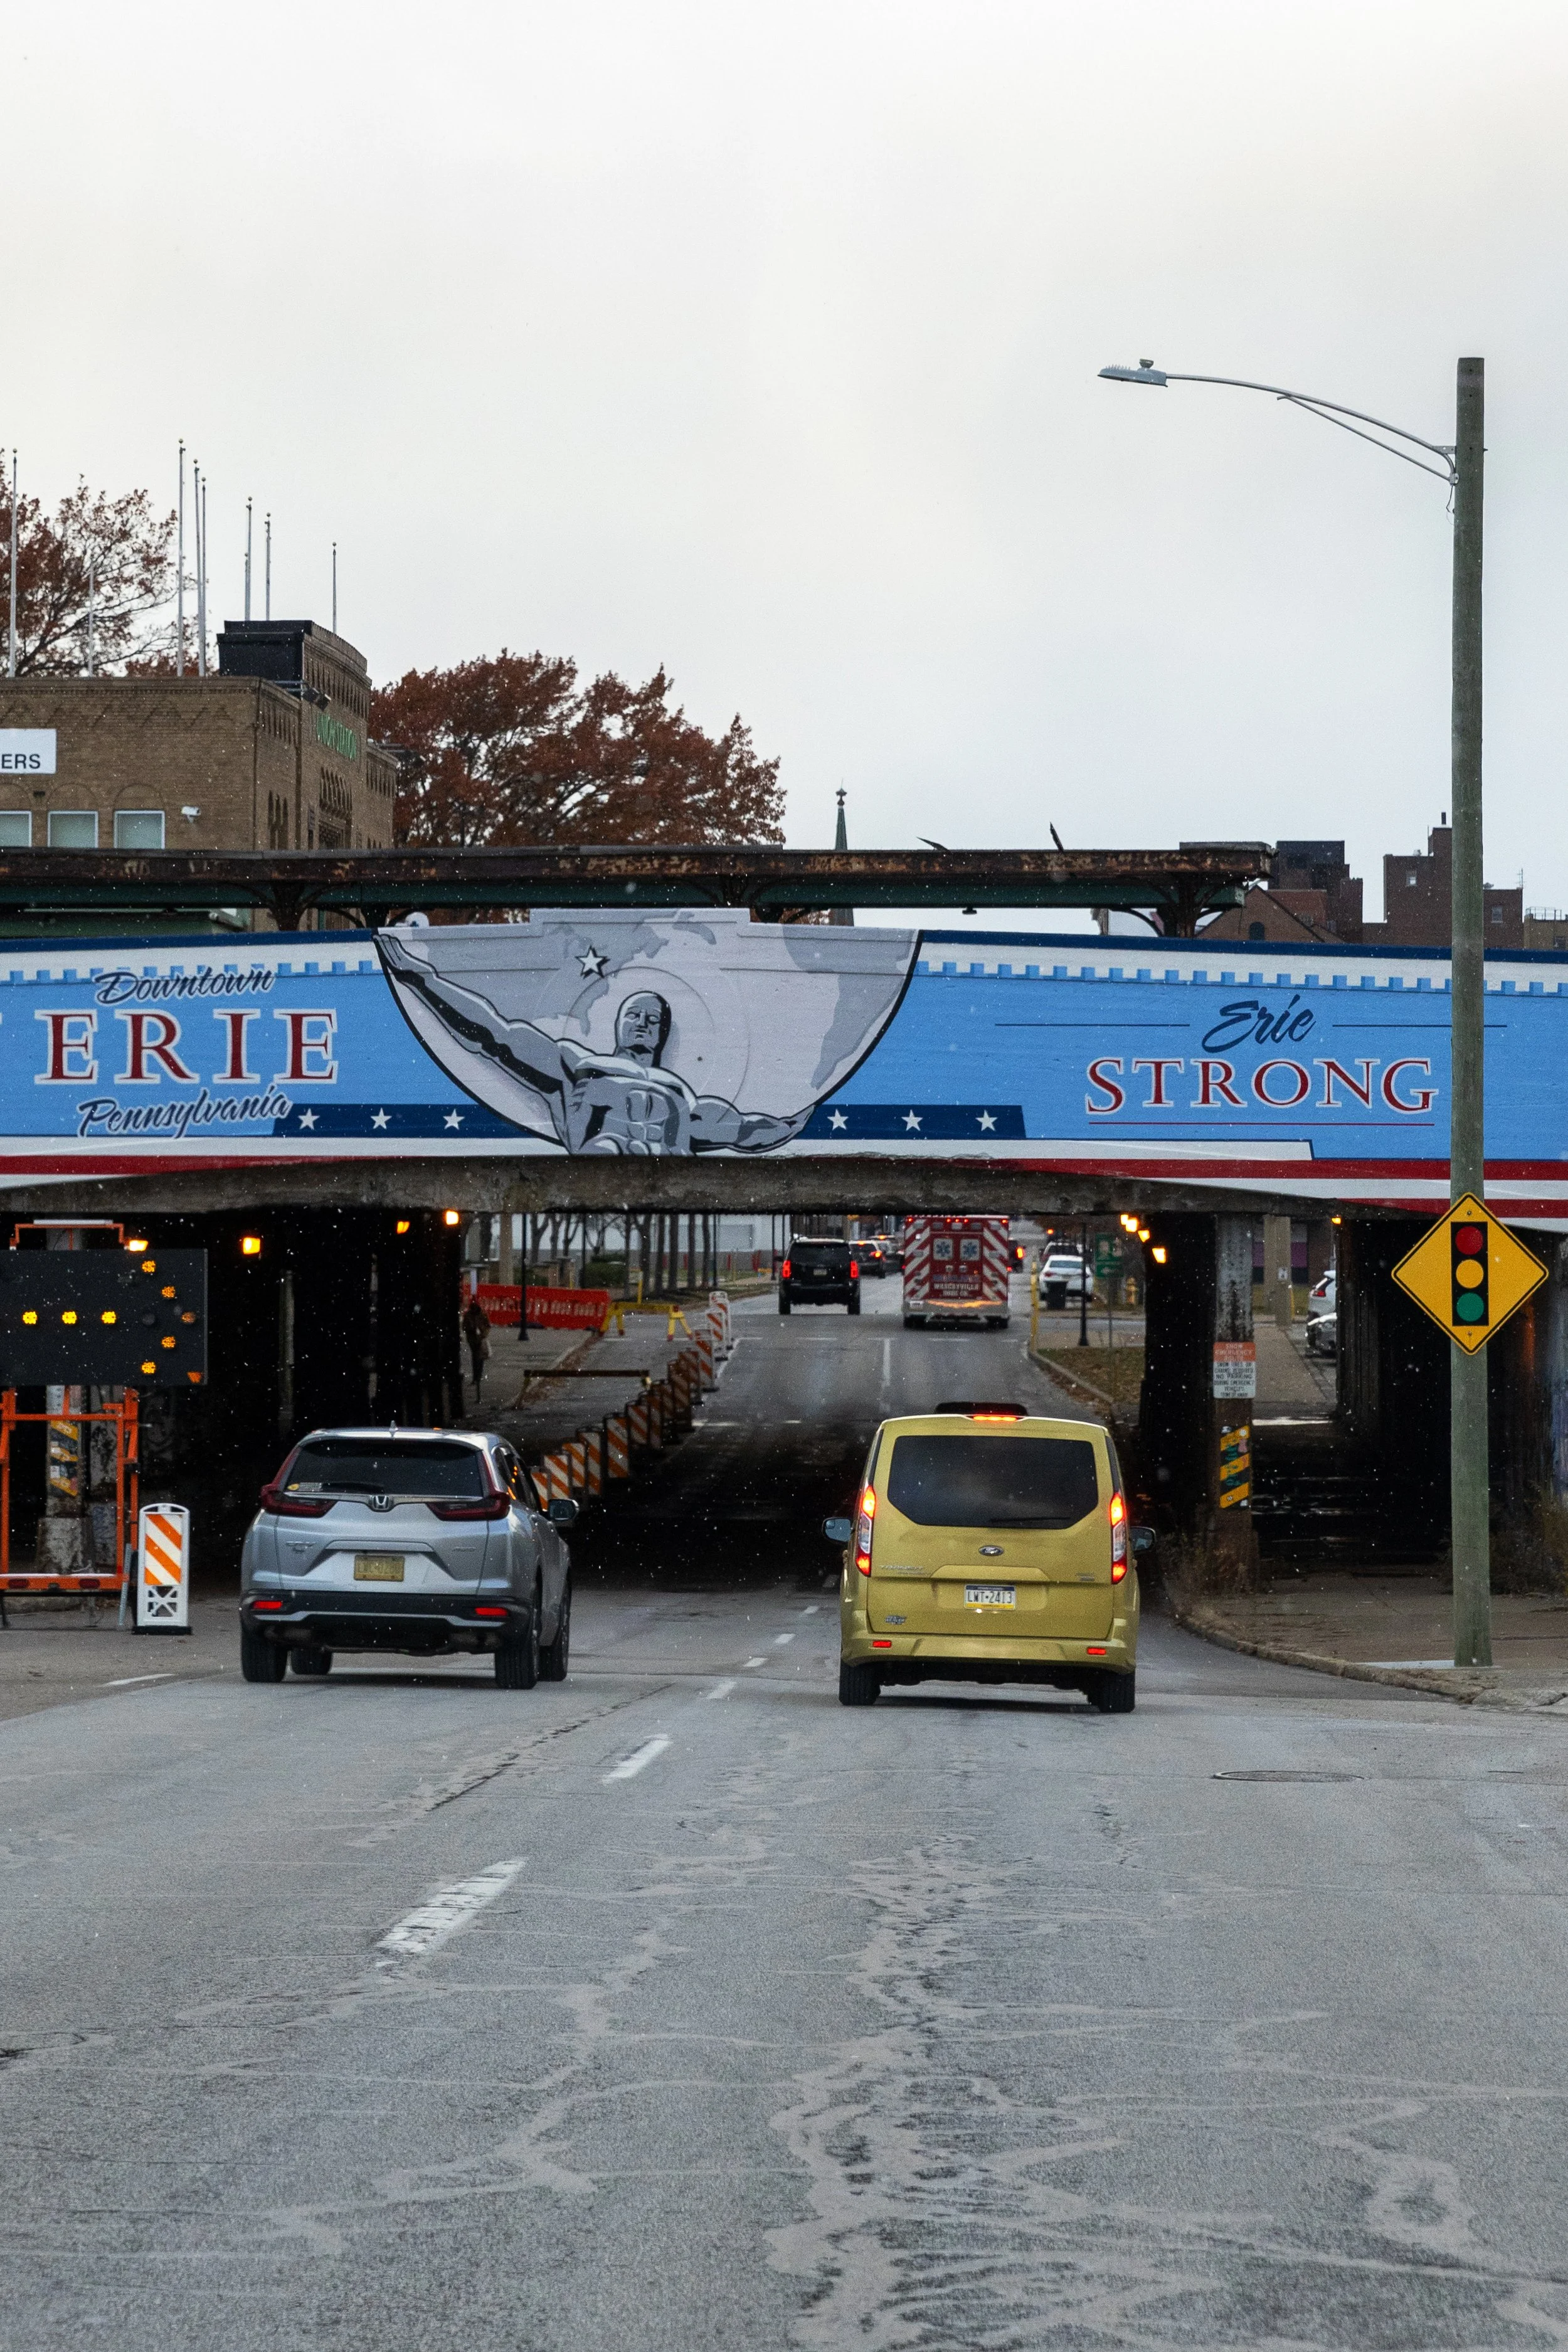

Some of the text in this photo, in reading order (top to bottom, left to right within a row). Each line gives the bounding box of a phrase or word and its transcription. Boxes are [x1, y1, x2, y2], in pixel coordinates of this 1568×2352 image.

[1, 753, 41, 769] ERS
[93, 967, 276, 1004] Downtown
[34, 1009, 338, 1084] ERIE
[1202, 994, 1316, 1053] Erie
[77, 1084, 293, 1139] Pennsylvania
[1086, 1057, 1438, 1115] STRONG
